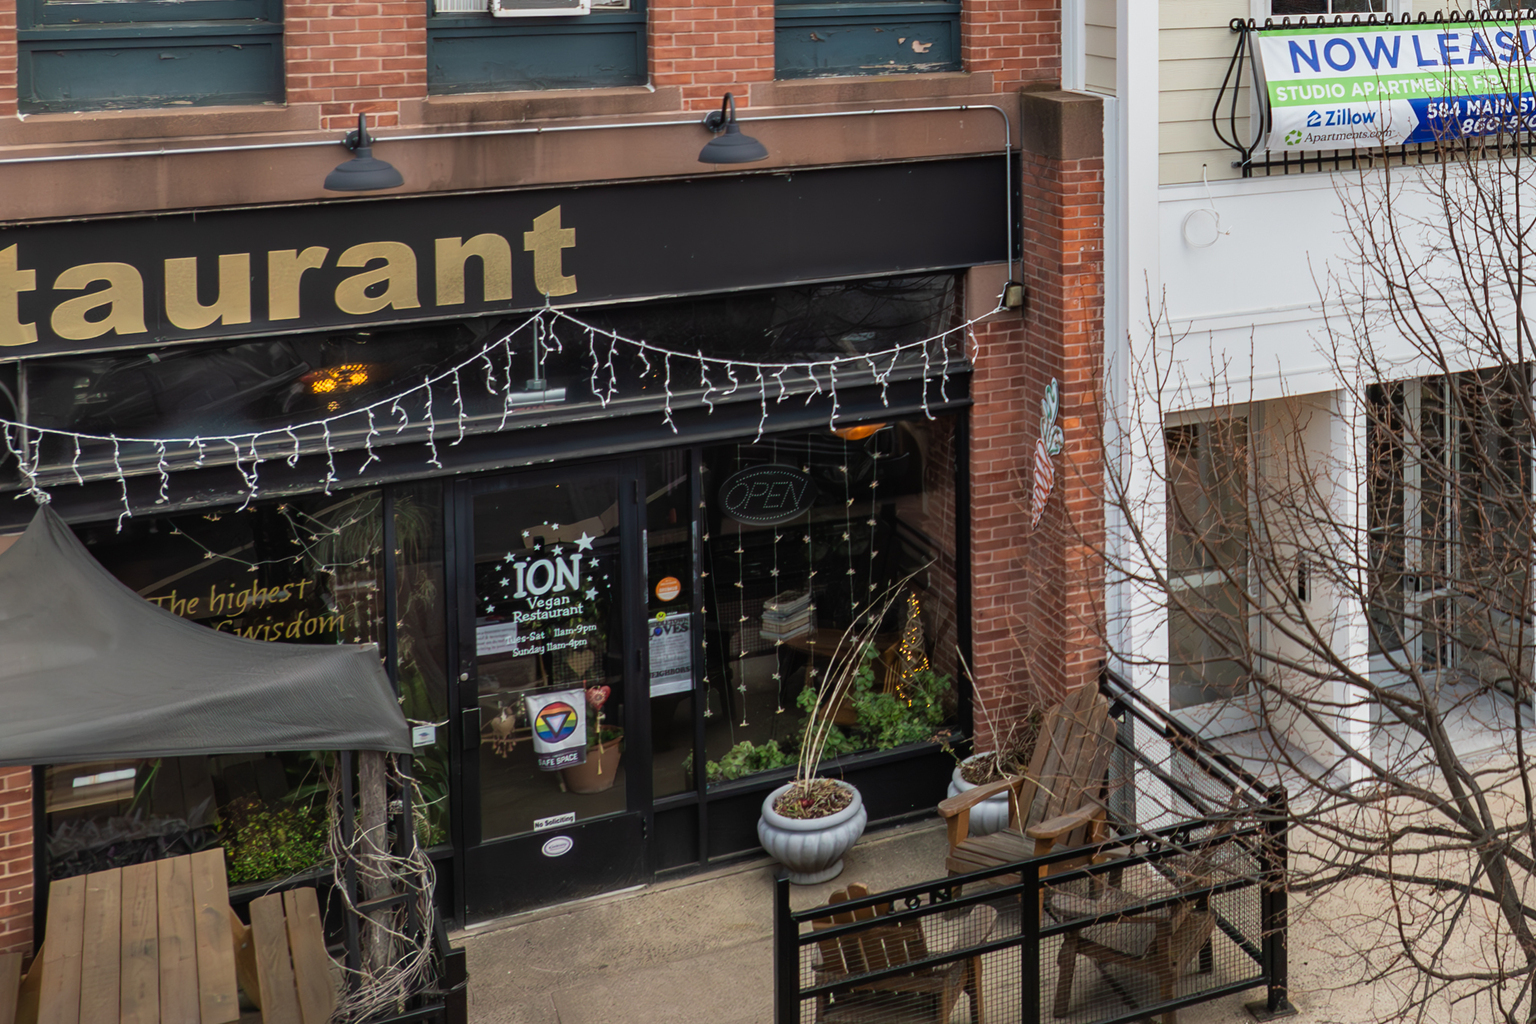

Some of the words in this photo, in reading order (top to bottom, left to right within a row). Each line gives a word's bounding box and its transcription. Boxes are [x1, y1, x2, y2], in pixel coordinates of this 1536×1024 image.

[1288, 35, 1401, 73] NOW
[1276, 83, 1345, 102] STUDIO
[1351, 75, 1468, 97] APARTMENTS
[1325, 108, 1376, 127] Zillow
[1427, 101, 1461, 119] 584
[1466, 97, 1512, 117] MAIN
[1304, 128, 1393, 145] Apartments.com
[725, 480, 809, 510] OPEN
[513, 553, 583, 599] ION
[145, 590, 200, 617] The
[209, 578, 313, 617] highest
[526, 595, 570, 611] Vegan
[512, 602, 584, 624] Restaurant
[505, 631, 546, 646] Tues-Sat
[553, 622, 598, 638] 11am-9pm
[512, 644, 545, 658] Sunday
[546, 638, 588, 652] 11am-4pm
[538, 758, 555, 766] SAFE
[556, 752, 578, 765] SPACE
[545, 815, 574, 826] Soliciting
